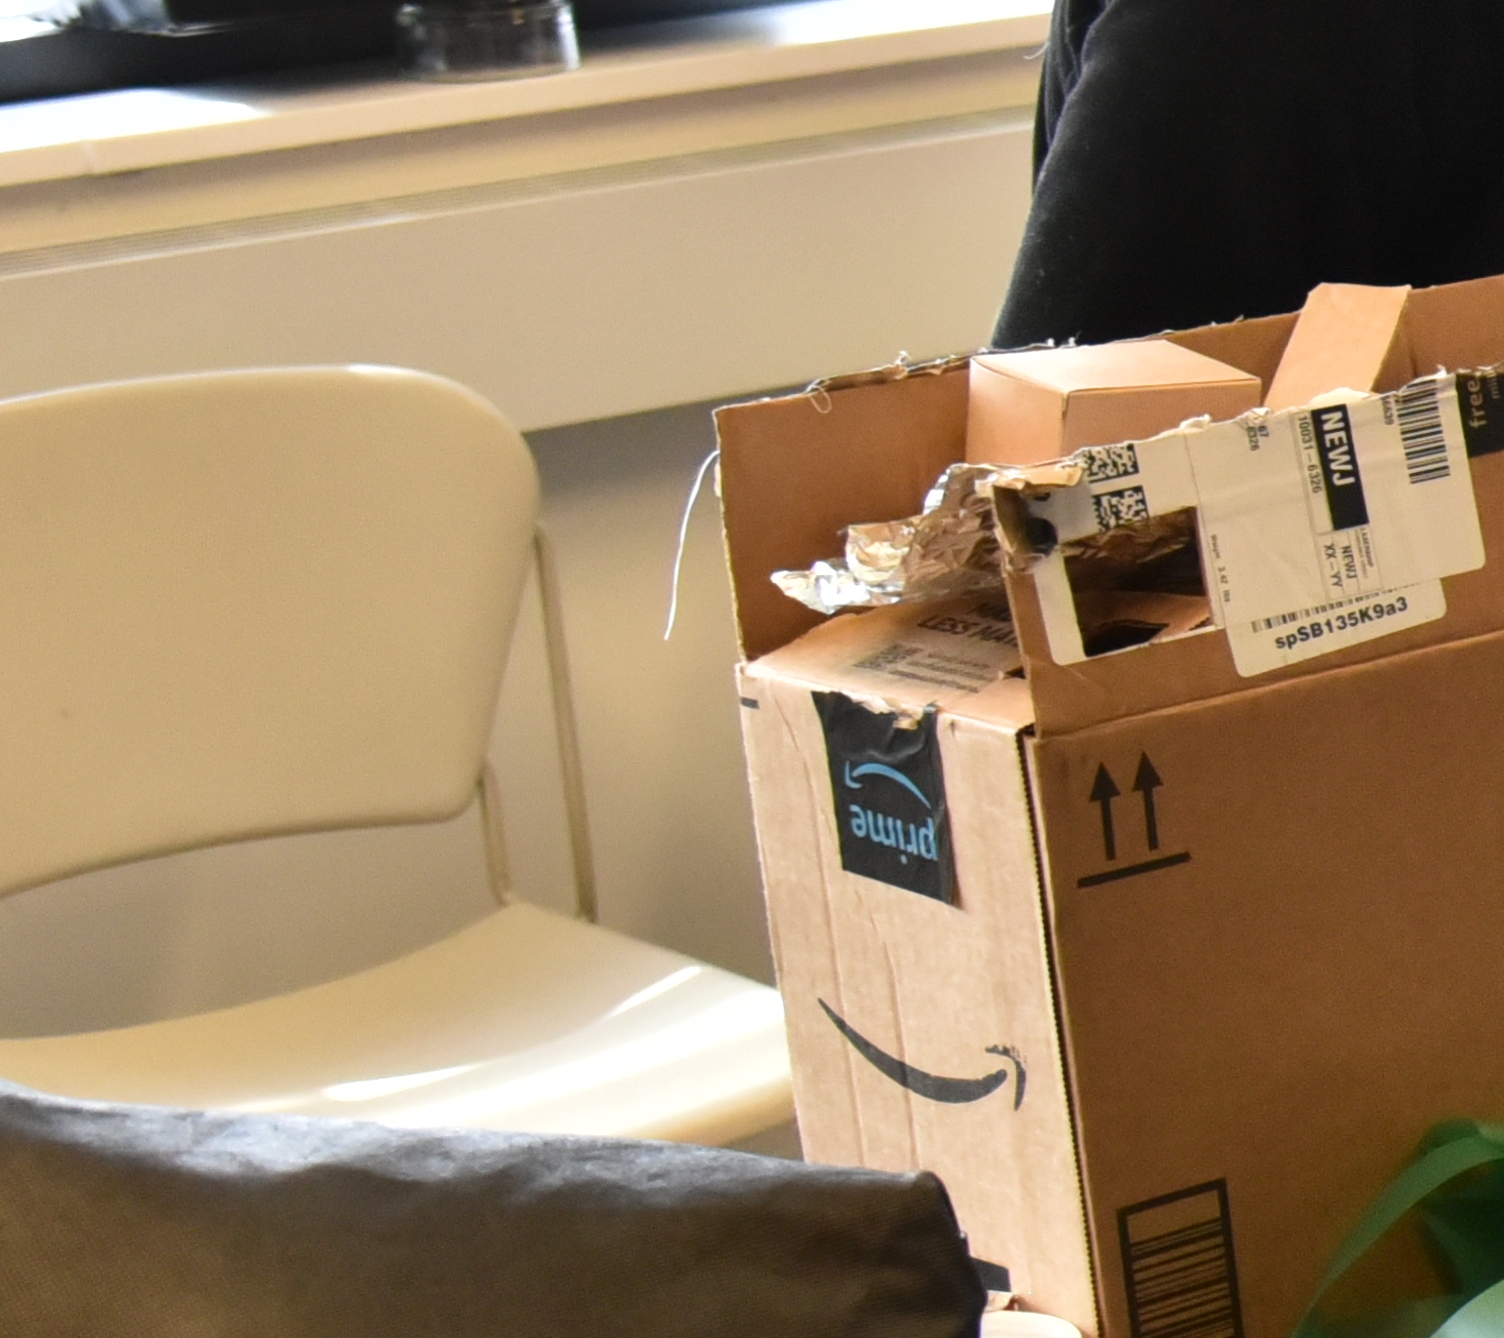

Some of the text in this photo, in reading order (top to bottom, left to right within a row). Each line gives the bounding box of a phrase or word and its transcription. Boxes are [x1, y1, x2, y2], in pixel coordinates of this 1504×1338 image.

[1467, 379, 1487, 428] free
[1321, 410, 1356, 486] NEWJ
[1341, 545, 1358, 579] NEWJ
[1275, 595, 1409, 650] spSB135K9a3
[850, 802, 938, 865] prime
